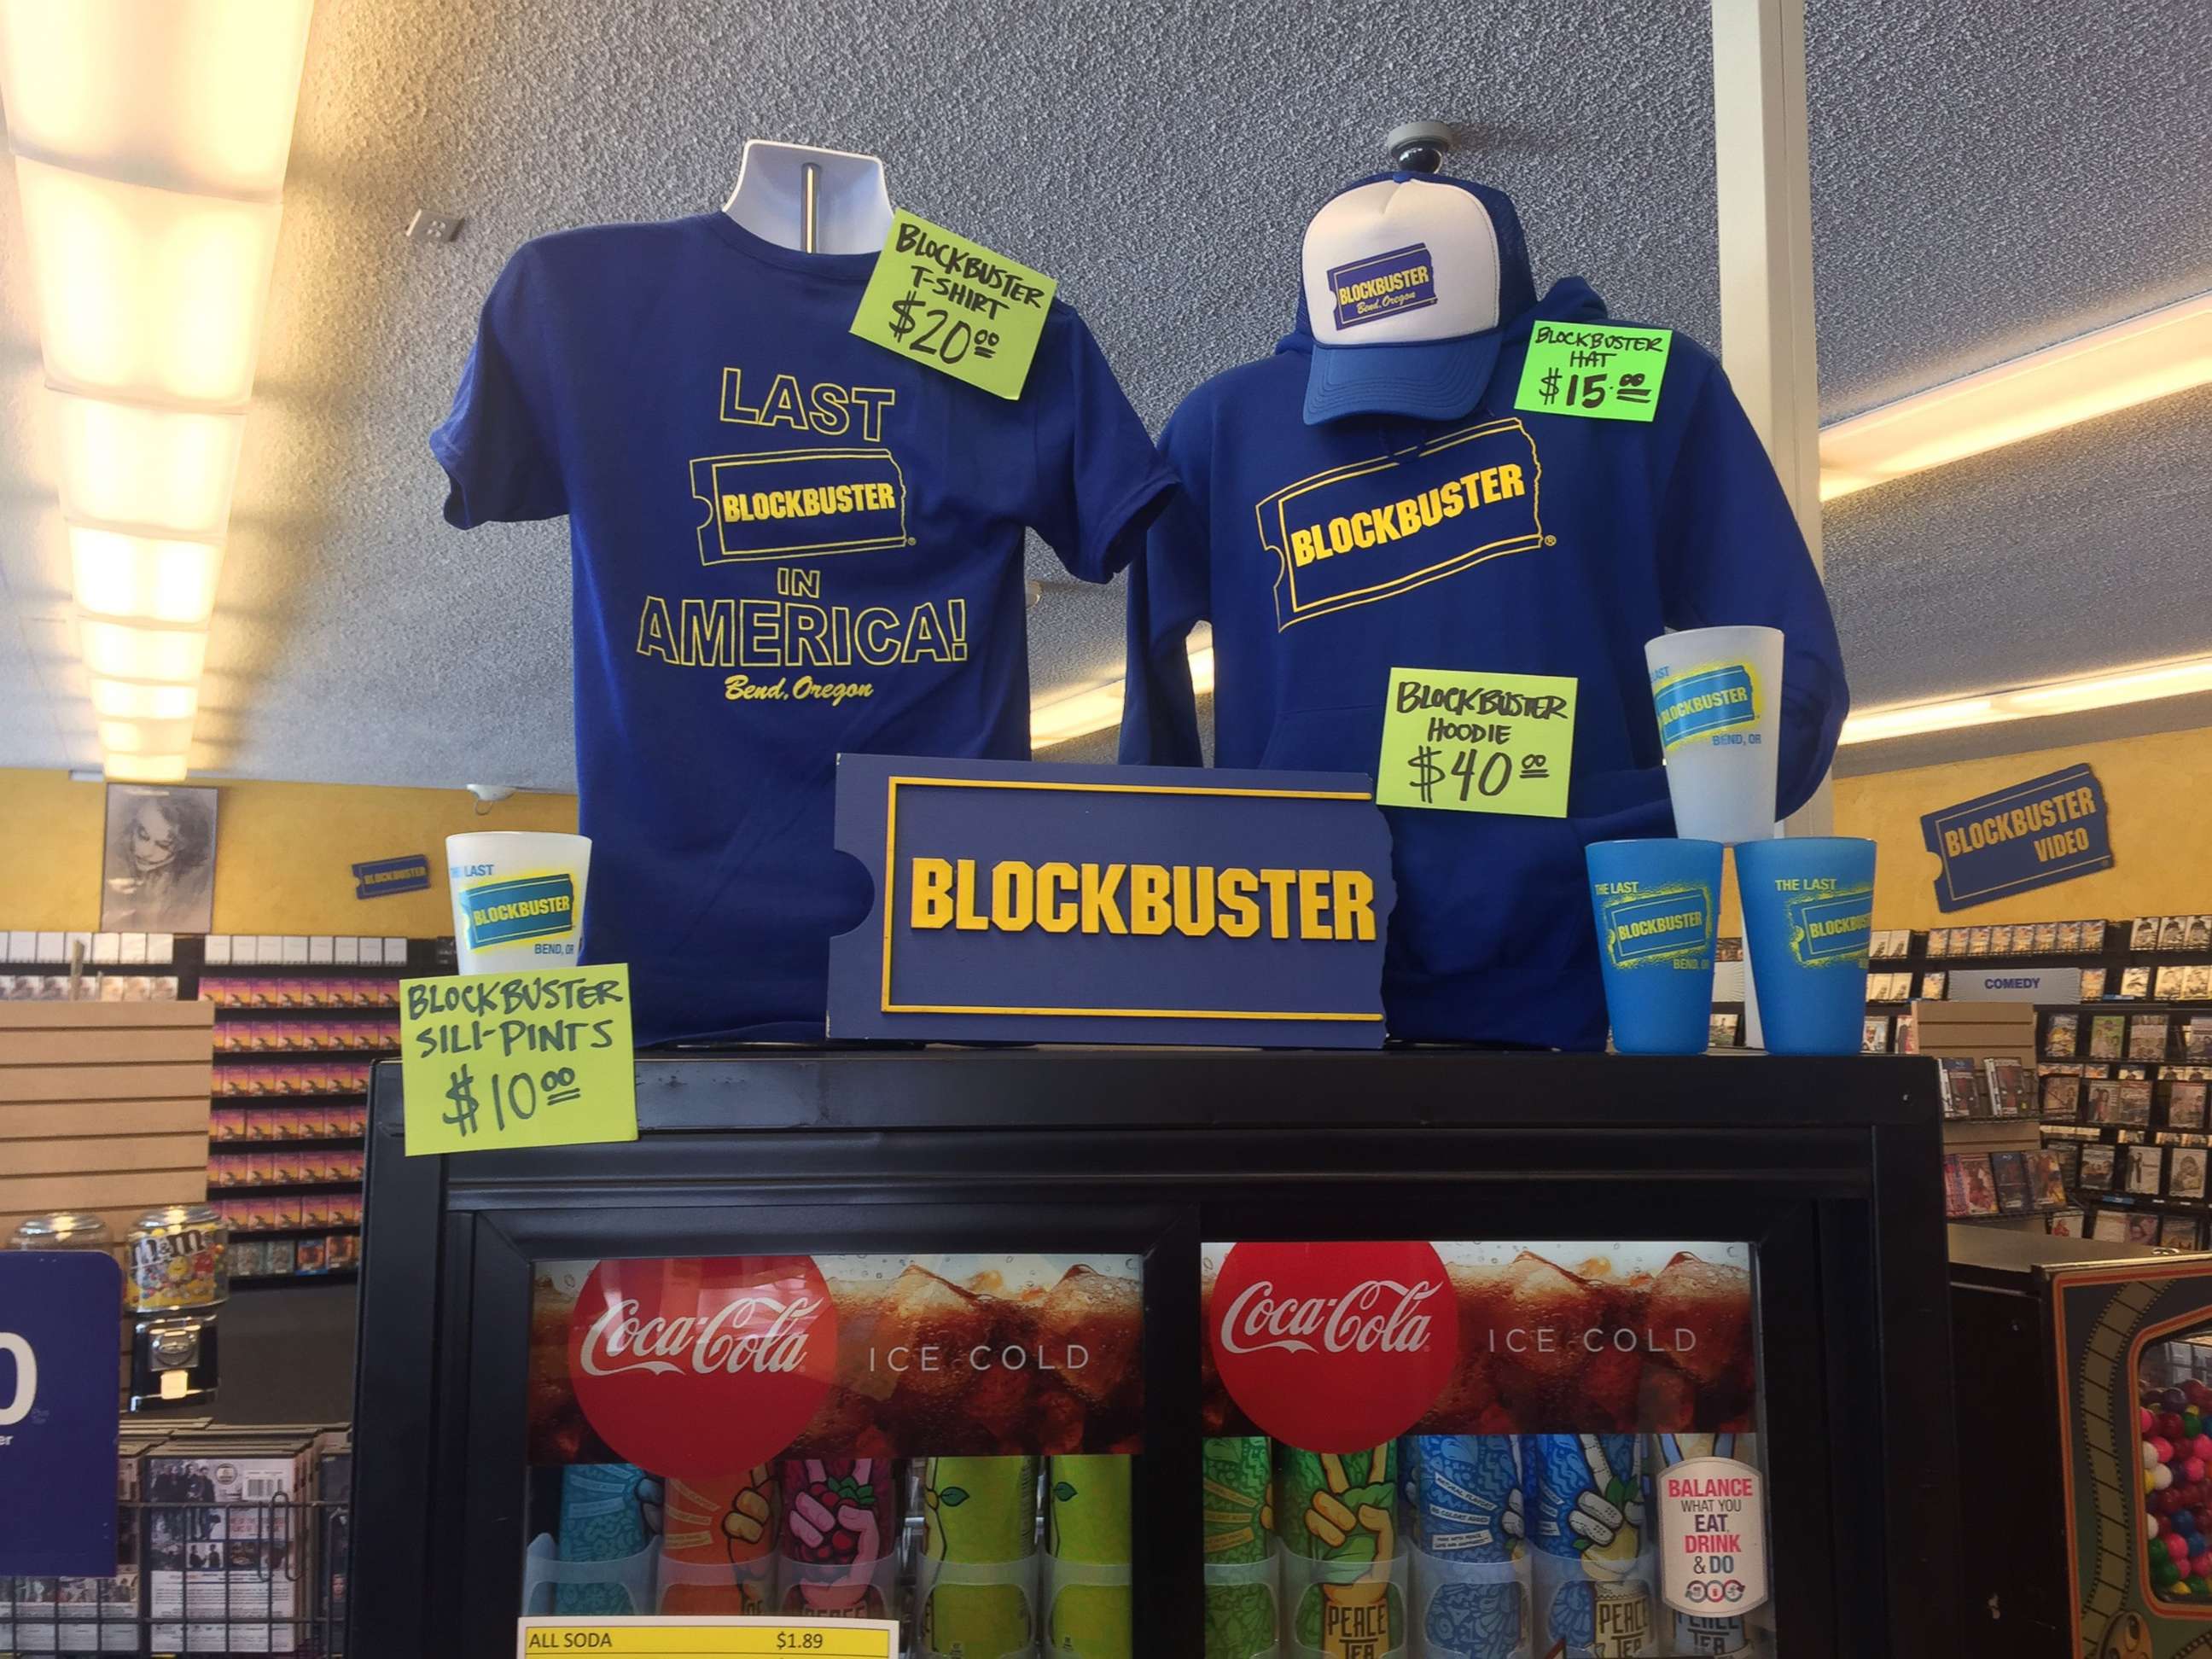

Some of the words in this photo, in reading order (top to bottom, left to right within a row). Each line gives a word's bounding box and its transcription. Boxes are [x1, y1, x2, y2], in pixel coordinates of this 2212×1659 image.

[895, 222, 1045, 309] BLOCKBUSTER
[910, 265, 1010, 320] T-SHIRT
[1338, 265, 1430, 306] BLOCKBUSTER
[1382, 291, 1417, 307] Oregon
[1535, 326, 1664, 352] BLOCKBUSTER
[1569, 350, 1617, 369] HAT
[719, 367, 896, 442] LAST
[722, 481, 896, 523] BLOCKBUSTER
[1289, 463, 1526, 568] BLOCKBUSTER
[777, 567, 820, 599] IN
[637, 595, 968, 667] AMERICA!
[792, 674, 875, 707] Oregon
[1396, 681, 1569, 720] BLOCKBUSTER
[1427, 716, 1512, 745] HOODIE
[1944, 785, 2097, 858] BLOCKBUSTER
[2033, 827, 2090, 863] VIDEO
[463, 864, 495, 877] LAST
[1775, 879, 1801, 891] THE
[1802, 878, 1837, 891] LAST
[910, 857, 1377, 942] BLOCKBUSTER
[1610, 882, 1639, 894] LAST
[473, 895, 571, 927] BLOCKBUSTER
[1617, 911, 1703, 940] BLOCKBUSTER
[407, 977, 624, 1021] BLOCKBUSTER
[1984, 977, 2040, 989] COMEDY
[416, 1019, 614, 1058] SILI-PINTS
[1489, 1328, 1555, 1353] ICE
[1583, 1328, 1697, 1353] COLD
[870, 1346, 940, 1372] ICE
[969, 1344, 1089, 1371] COLD
[1668, 1478, 1753, 1498] BALANCE
[1680, 1499, 1715, 1513] WHAT
[1719, 1499, 1742, 1513] YOU
[1685, 1534, 1742, 1554] DRINK
[1692, 1556, 1707, 1575] &
[1708, 1555, 1734, 1574] DO
[1329, 1604, 1386, 1637] PEACE
[528, 1633, 560, 1649] ALL
[563, 1633, 613, 1650] SODA
[776, 1632, 824, 1650] $1.89
